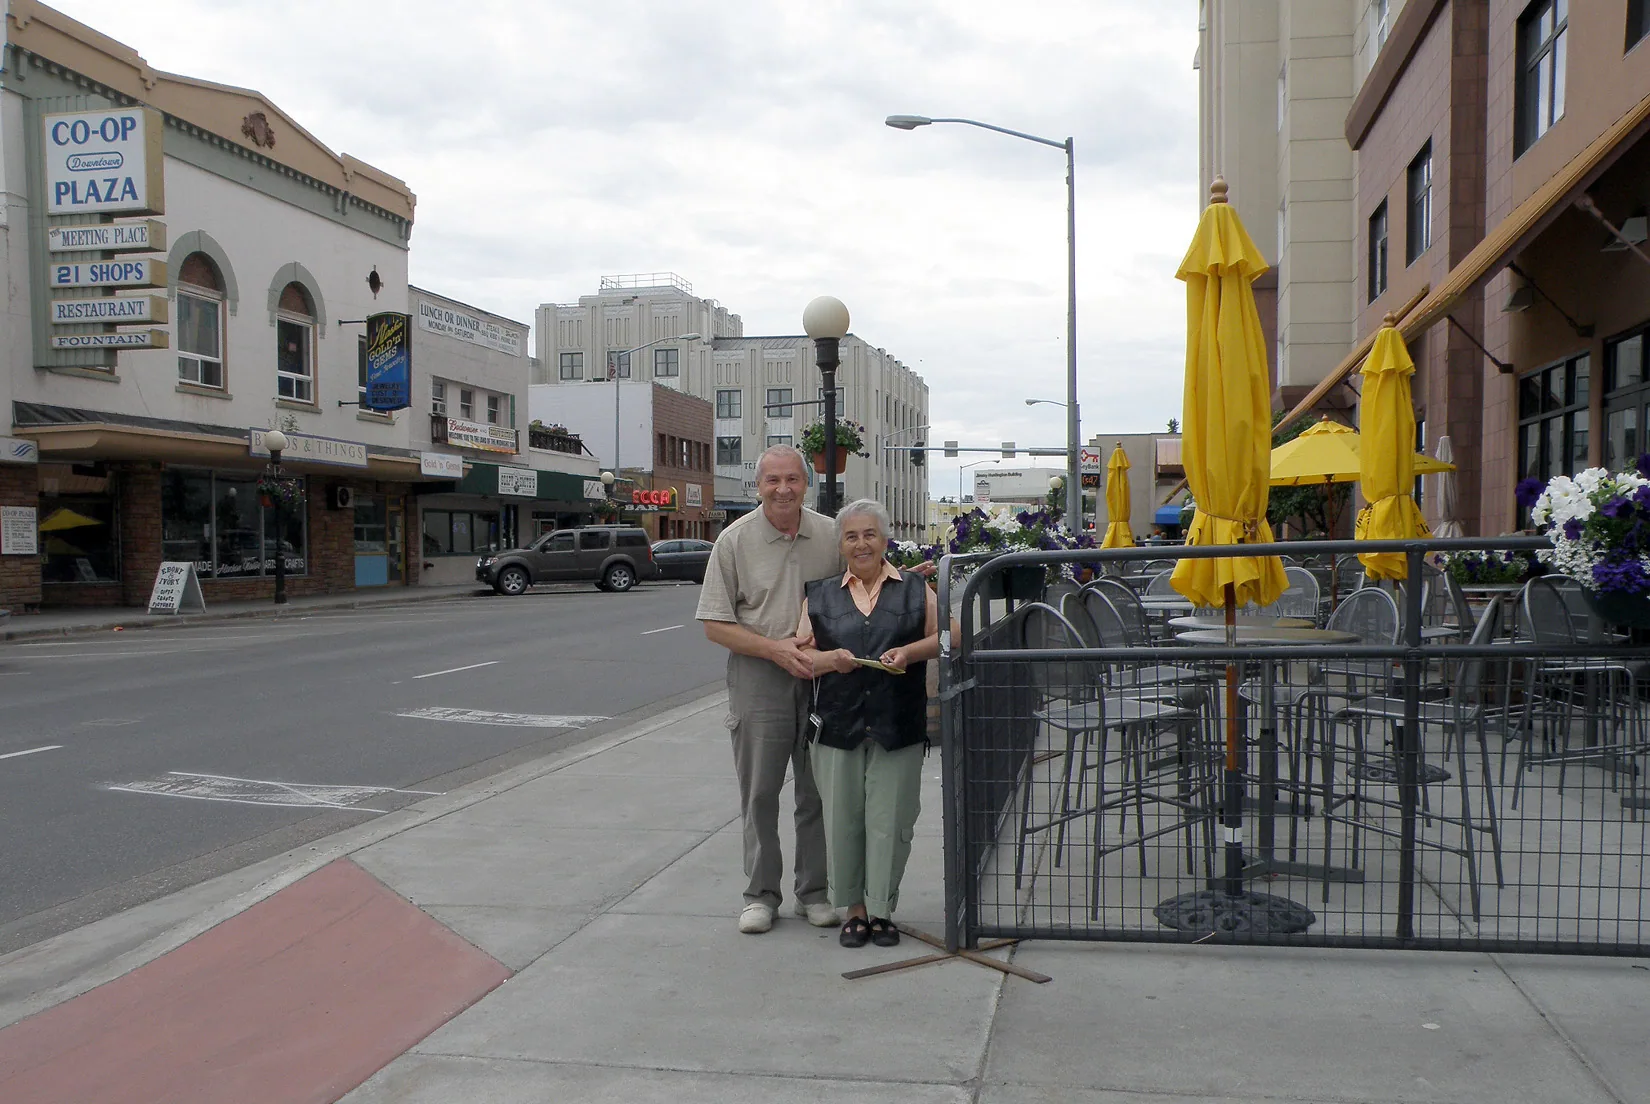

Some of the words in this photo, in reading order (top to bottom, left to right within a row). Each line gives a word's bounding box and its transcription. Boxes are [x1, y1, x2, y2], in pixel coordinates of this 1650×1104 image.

[52, 116, 137, 146] CO-OP
[72, 156, 121, 169] Downtown
[55, 177, 139, 205] PLAZA
[62, 229, 109, 246] MEETING
[114, 227, 147, 243] PLACE
[57, 266, 79, 283] 21
[90, 262, 143, 282] SHOPS
[57, 301, 144, 319] RESTAURANT
[420, 303, 443, 321] LUNCH
[444, 311, 454, 325] OR
[456, 314, 480, 333] DINNER
[428, 319, 446, 332] MONDAY
[454, 327, 475, 340] SATURDAY
[58, 334, 146, 346] FOUNTAIN
[373, 346, 398, 369] GEMS
[449, 419, 479, 433] Budweiser
[255, 433, 298, 451] BDS
[303, 439, 311, 452] &
[317, 440, 363, 459] THINGS
[424, 459, 436, 469] Gold
[446, 461, 460, 471] Gems
[161, 566, 184, 575] EBONY
[284, 558, 304, 569] CRAFTS
